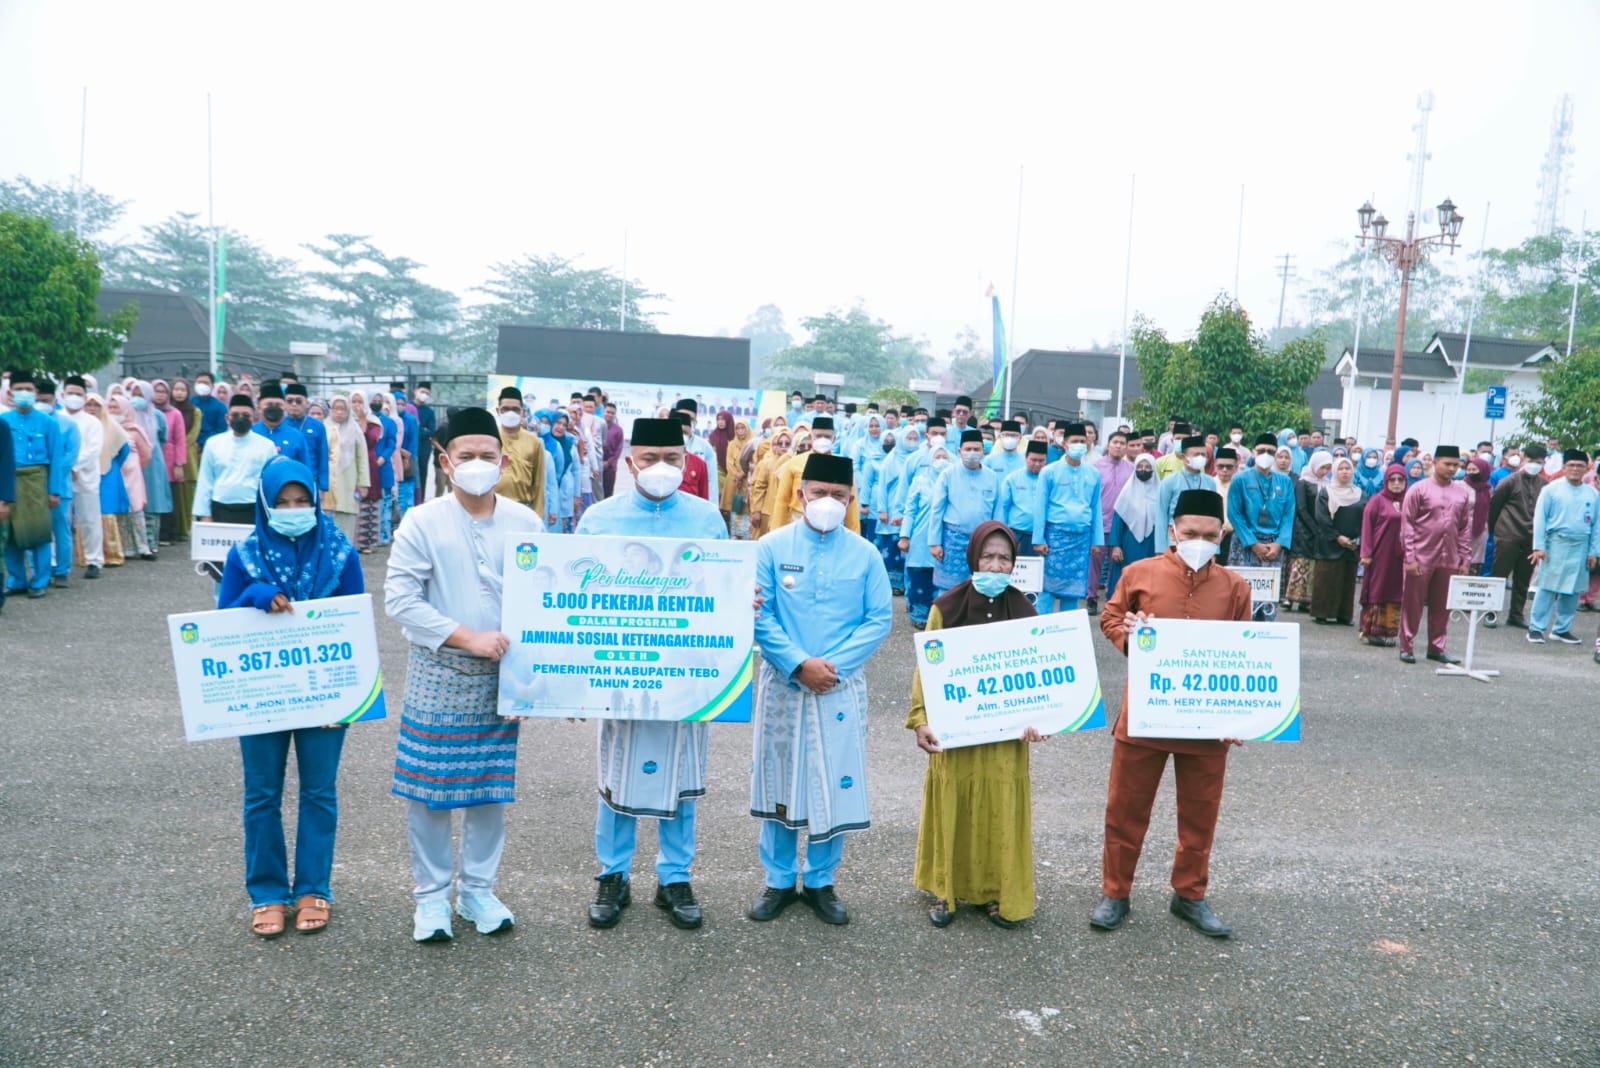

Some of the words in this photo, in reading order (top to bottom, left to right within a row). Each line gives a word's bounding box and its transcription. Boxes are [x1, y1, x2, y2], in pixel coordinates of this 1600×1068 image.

[1489, 388, 1496, 400] P
[570, 557, 689, 593] Perlindungan
[1249, 579, 1274, 590] TORAT
[543, 592, 587, 609] 5.000
[592, 594, 654, 611] PEKERJA
[658, 596, 714, 612] RENTAN
[579, 617, 617, 626] DALAM
[621, 618, 677, 628] PROGRAM
[521, 630, 574, 645] JAMINAN
[577, 631, 619, 646] SOSIAL
[622, 633, 734, 648] KETENAGAKERJAAN
[202, 658, 233, 678] Rp.
[239, 642, 353, 672] 367.901.320
[972, 646, 1038, 663] SANTUNAN
[1183, 649, 1246, 658] SANTUNAN
[533, 664, 611, 675] PEMERINTAH
[615, 666, 686, 677] KABUPATEN
[689, 667, 719, 678] TEBO
[948, 662, 1001, 677] JAMINAN
[1005, 652, 1066, 668] KEMATIAN
[1156, 659, 1209, 669] JAMINAN
[1213, 660, 1272, 669] KEMATIAN
[589, 678, 630, 689] TAHUN
[633, 679, 662, 689] 2026
[944, 683, 971, 703] Rp.
[977, 665, 1076, 695] 42.000.000
[1150, 673, 1176, 693] Rp.
[1182, 673, 1277, 692] 42.000.000
[227, 703, 250, 712] ALM.
[254, 699, 285, 710] JHONI
[288, 692, 341, 705] ISKANDAR
[977, 702, 1000, 712] Alm.
[1003, 694, 1049, 708] SUHAIMI
[1147, 697, 1171, 706] Alm.
[1174, 698, 1201, 706] HERY
[1206, 699, 1281, 708] FARMANSYAH
